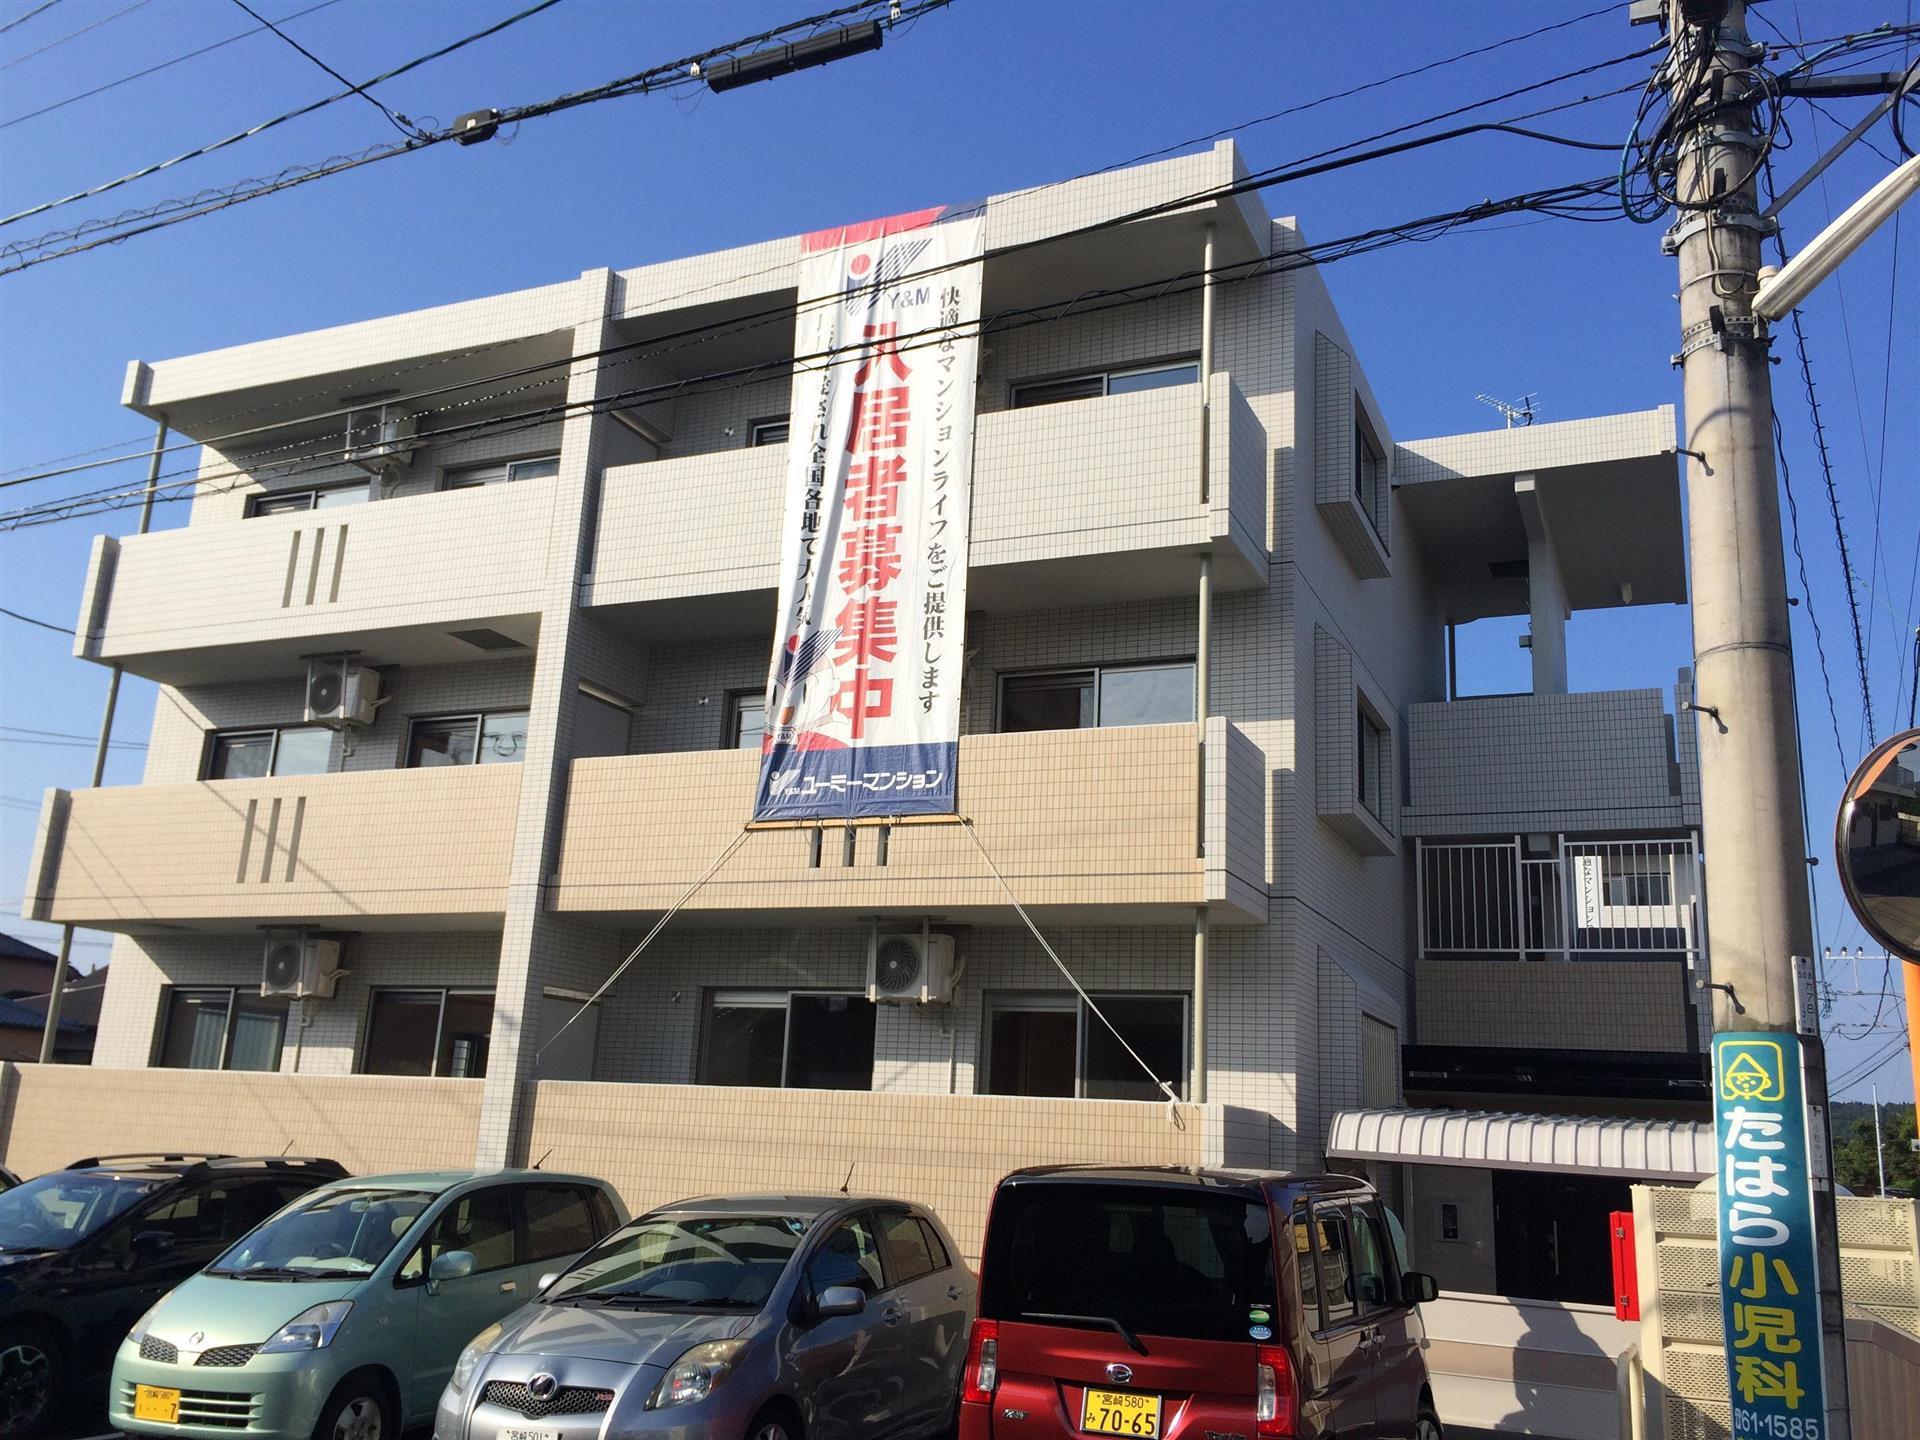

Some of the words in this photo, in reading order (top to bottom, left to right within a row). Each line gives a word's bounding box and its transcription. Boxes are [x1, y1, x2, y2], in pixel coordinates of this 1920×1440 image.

[888, 286, 930, 310] Y&M
[830, 320, 914, 740] 入居者募集中
[801, 769, 943, 795] ユーミーマンション
[1723, 1105, 1806, 1410] たはら小児科
[1100, 1407, 1156, 1436] 70-65
